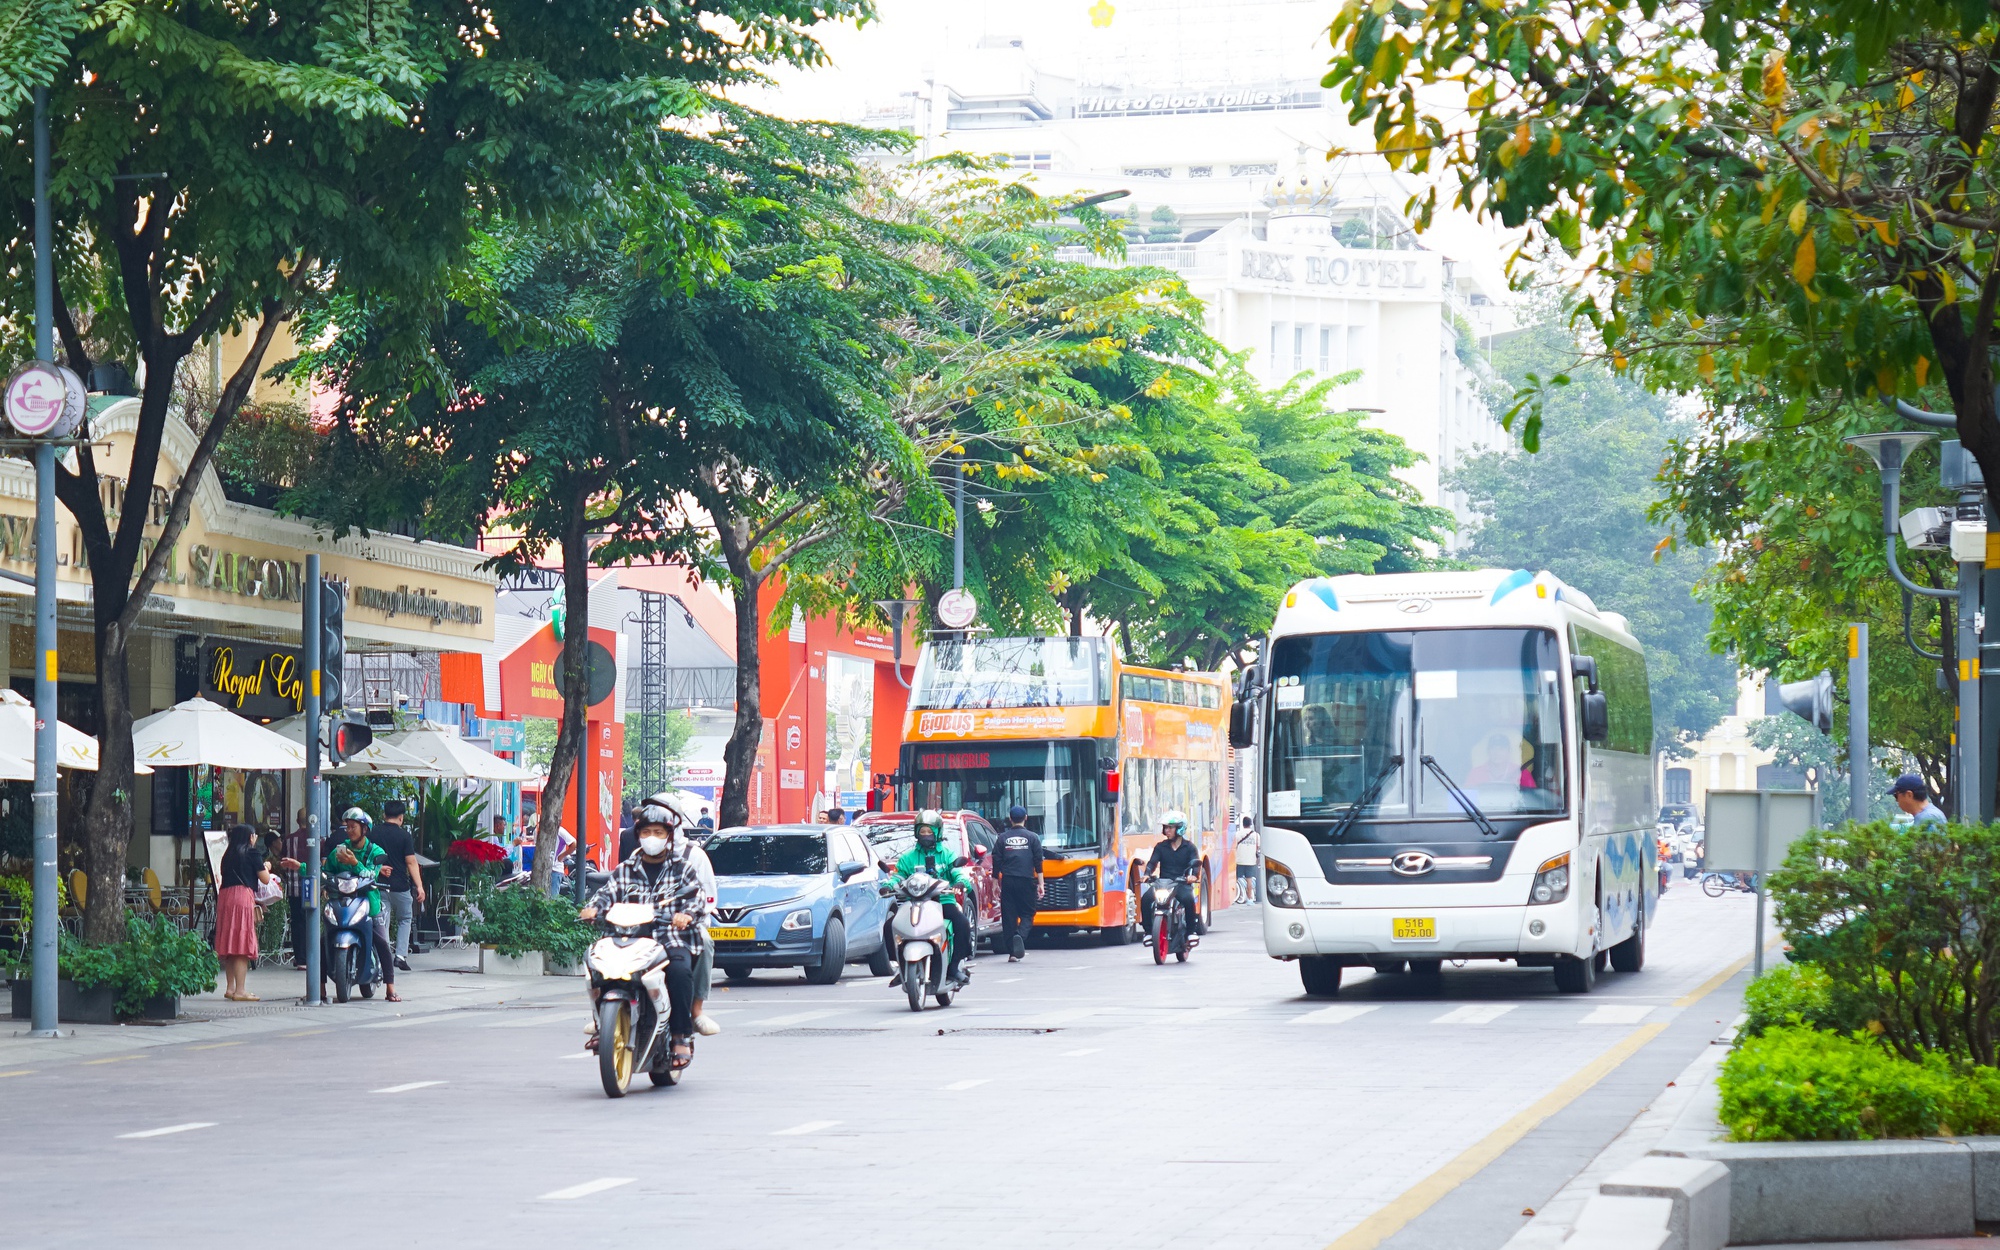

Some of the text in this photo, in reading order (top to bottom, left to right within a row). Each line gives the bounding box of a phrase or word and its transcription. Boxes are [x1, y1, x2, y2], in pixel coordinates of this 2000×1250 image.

[1241, 249, 1426, 288] REX HOTEL
[189, 543, 302, 603] SAIGON
[213, 647, 265, 708] Royal
[984, 715, 1065, 725] Saigon Heritage tour
[922, 753, 990, 769] VIET BIGBUS
[1405, 919, 1424, 928] 51B
[708, 930, 751, 938] 0H-474.07
[1398, 929, 1432, 938] 075.00
